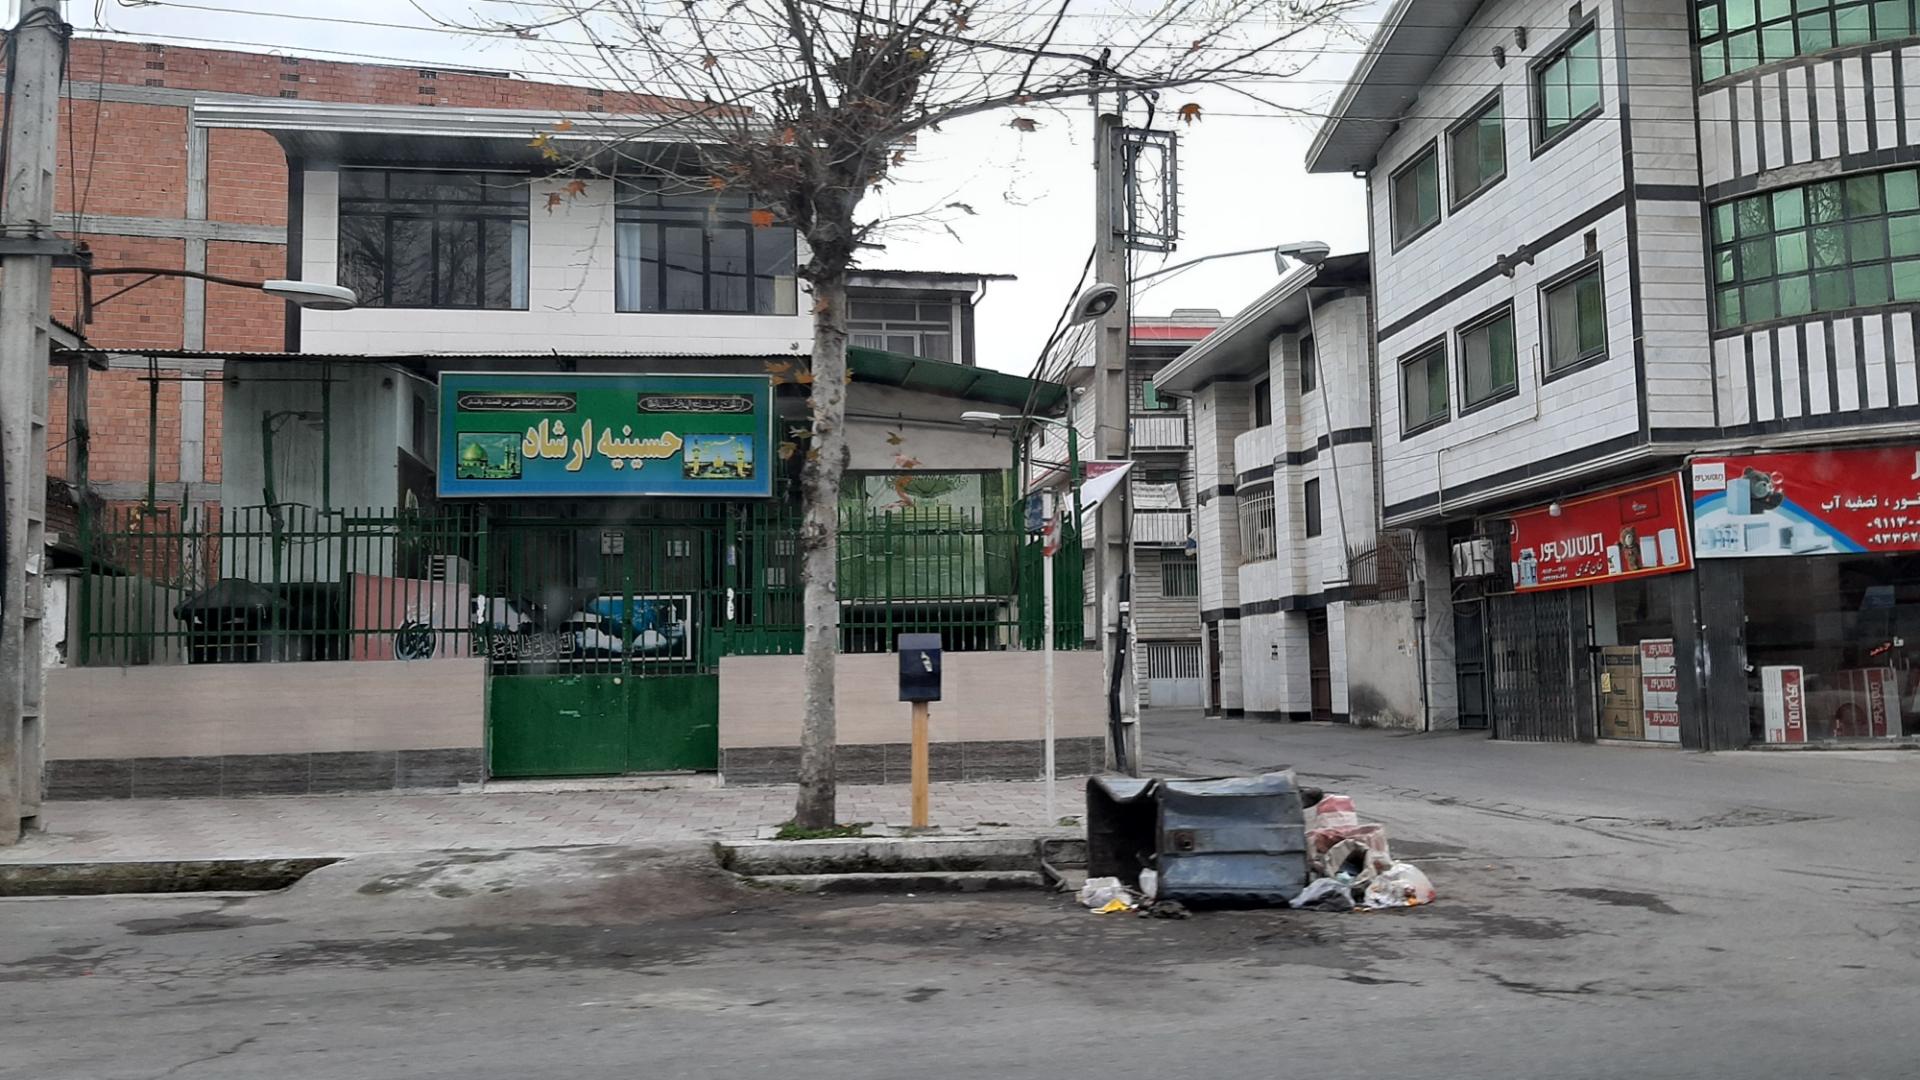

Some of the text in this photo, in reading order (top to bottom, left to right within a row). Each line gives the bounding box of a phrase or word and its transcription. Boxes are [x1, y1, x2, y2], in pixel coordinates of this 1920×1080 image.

[522, 418, 683, 471] حسینیه ارشاد
[1821, 494, 1840, 513] آب
[1845, 496, 1878, 512] تصفیه
[1577, 532, 1604, 556] ایران
